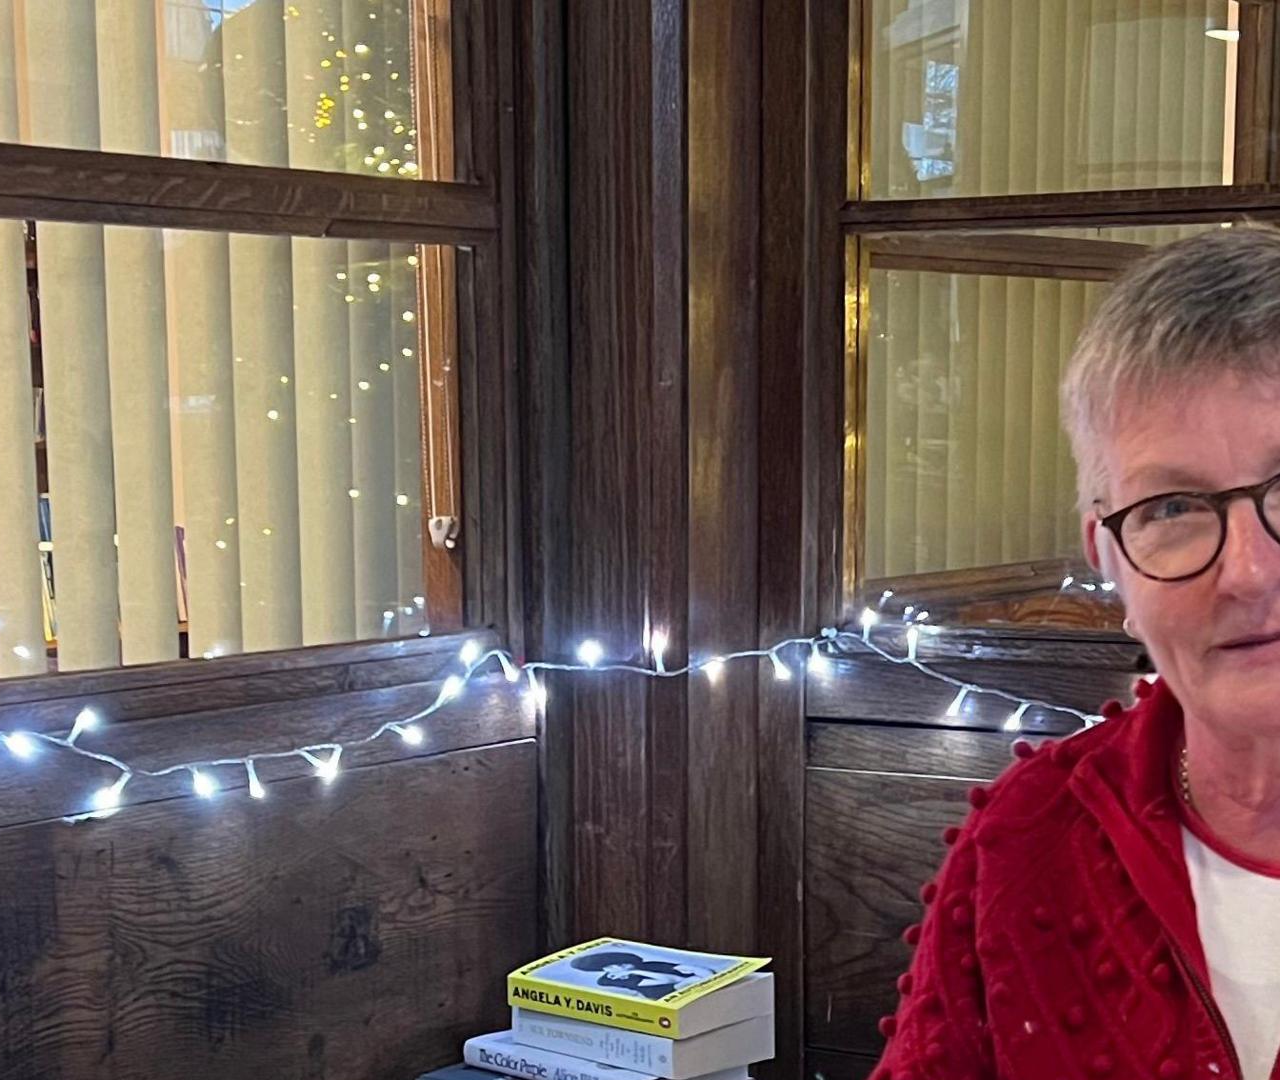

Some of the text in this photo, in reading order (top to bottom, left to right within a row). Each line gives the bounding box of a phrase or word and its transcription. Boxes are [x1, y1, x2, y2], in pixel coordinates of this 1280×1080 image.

[512, 985, 566, 1008] ANGELA
[575, 1001, 613, 1018] DAVIS
[479, 1048, 493, 1064] The
[494, 1052, 519, 1072] Color
[520, 1058, 548, 1079] Purple
